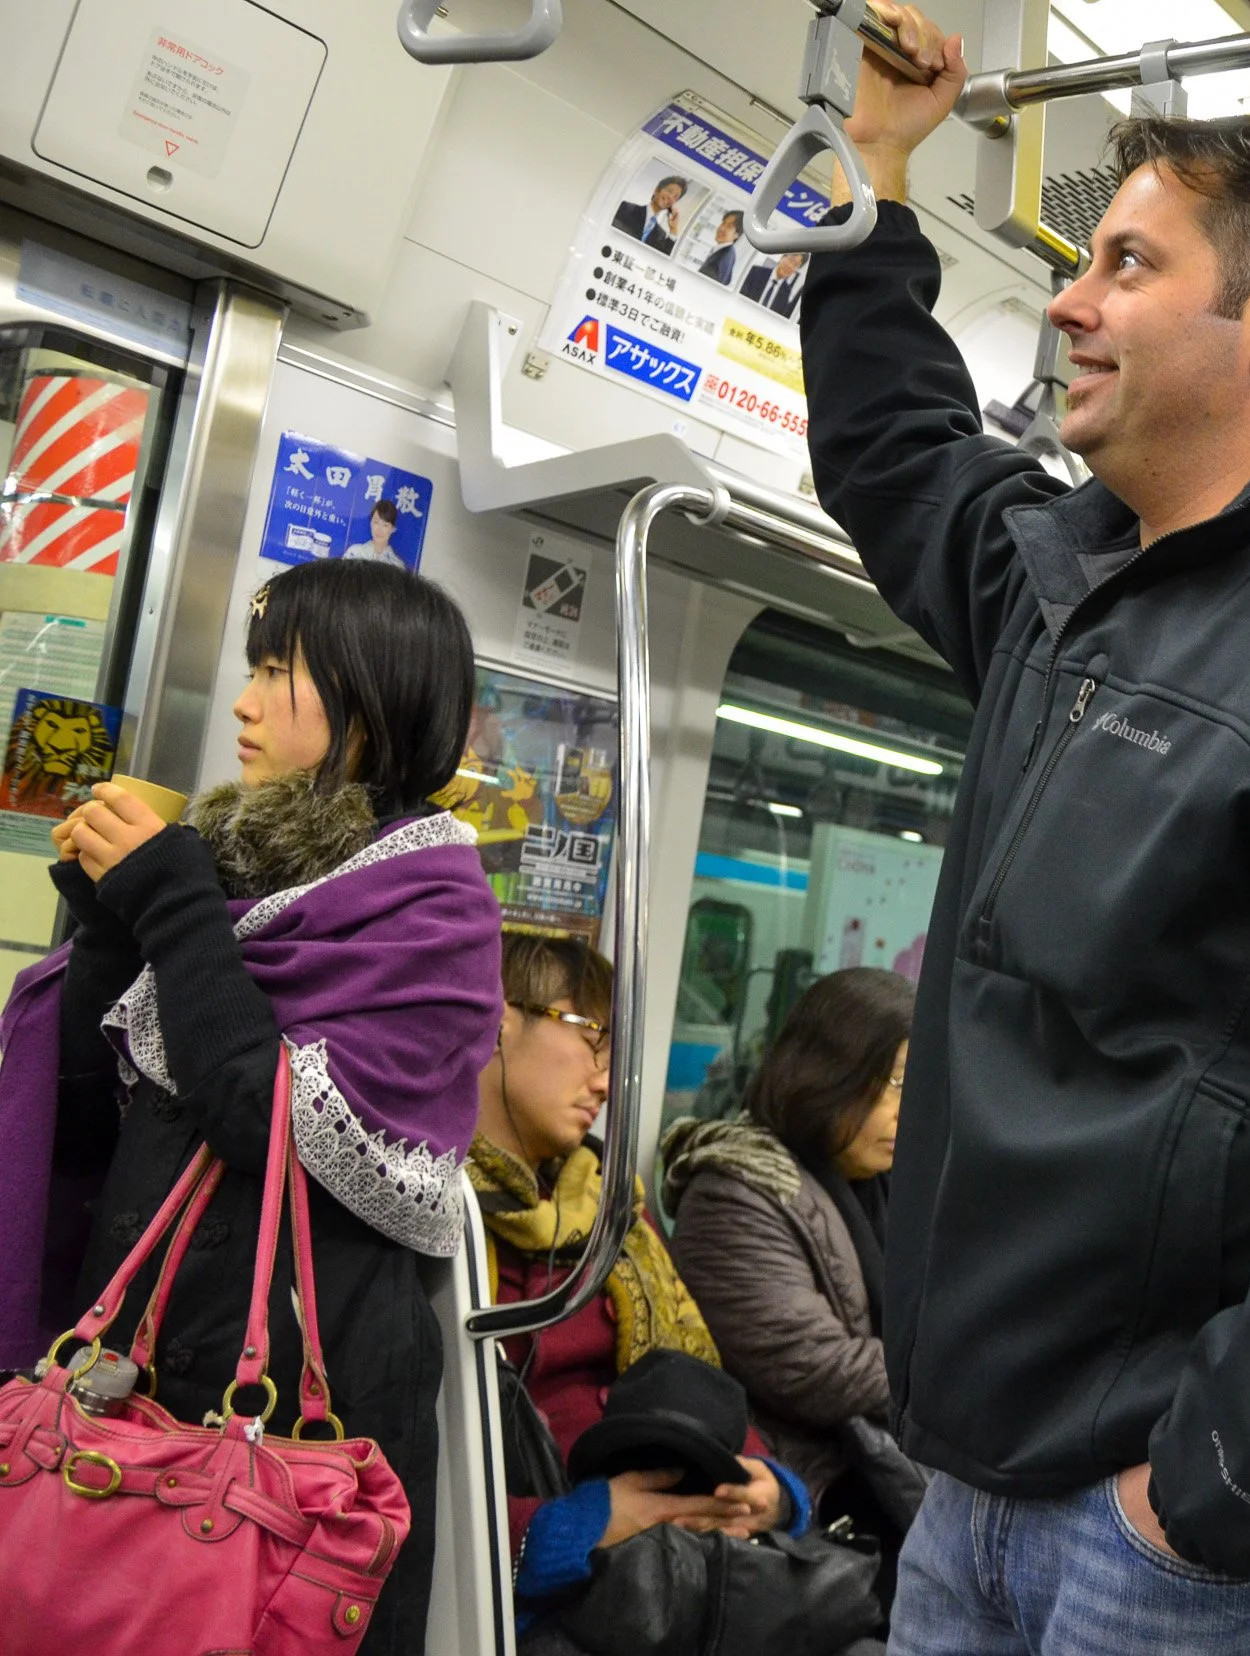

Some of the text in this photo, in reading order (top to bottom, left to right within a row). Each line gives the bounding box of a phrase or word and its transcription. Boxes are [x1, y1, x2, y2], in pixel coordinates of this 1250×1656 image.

[158, 37, 224, 75] 非常用ドアコック
[561, 343, 597, 366] ASAX
[608, 335, 699, 397] アサックス
[1092, 712, 1172, 755] Columbia
